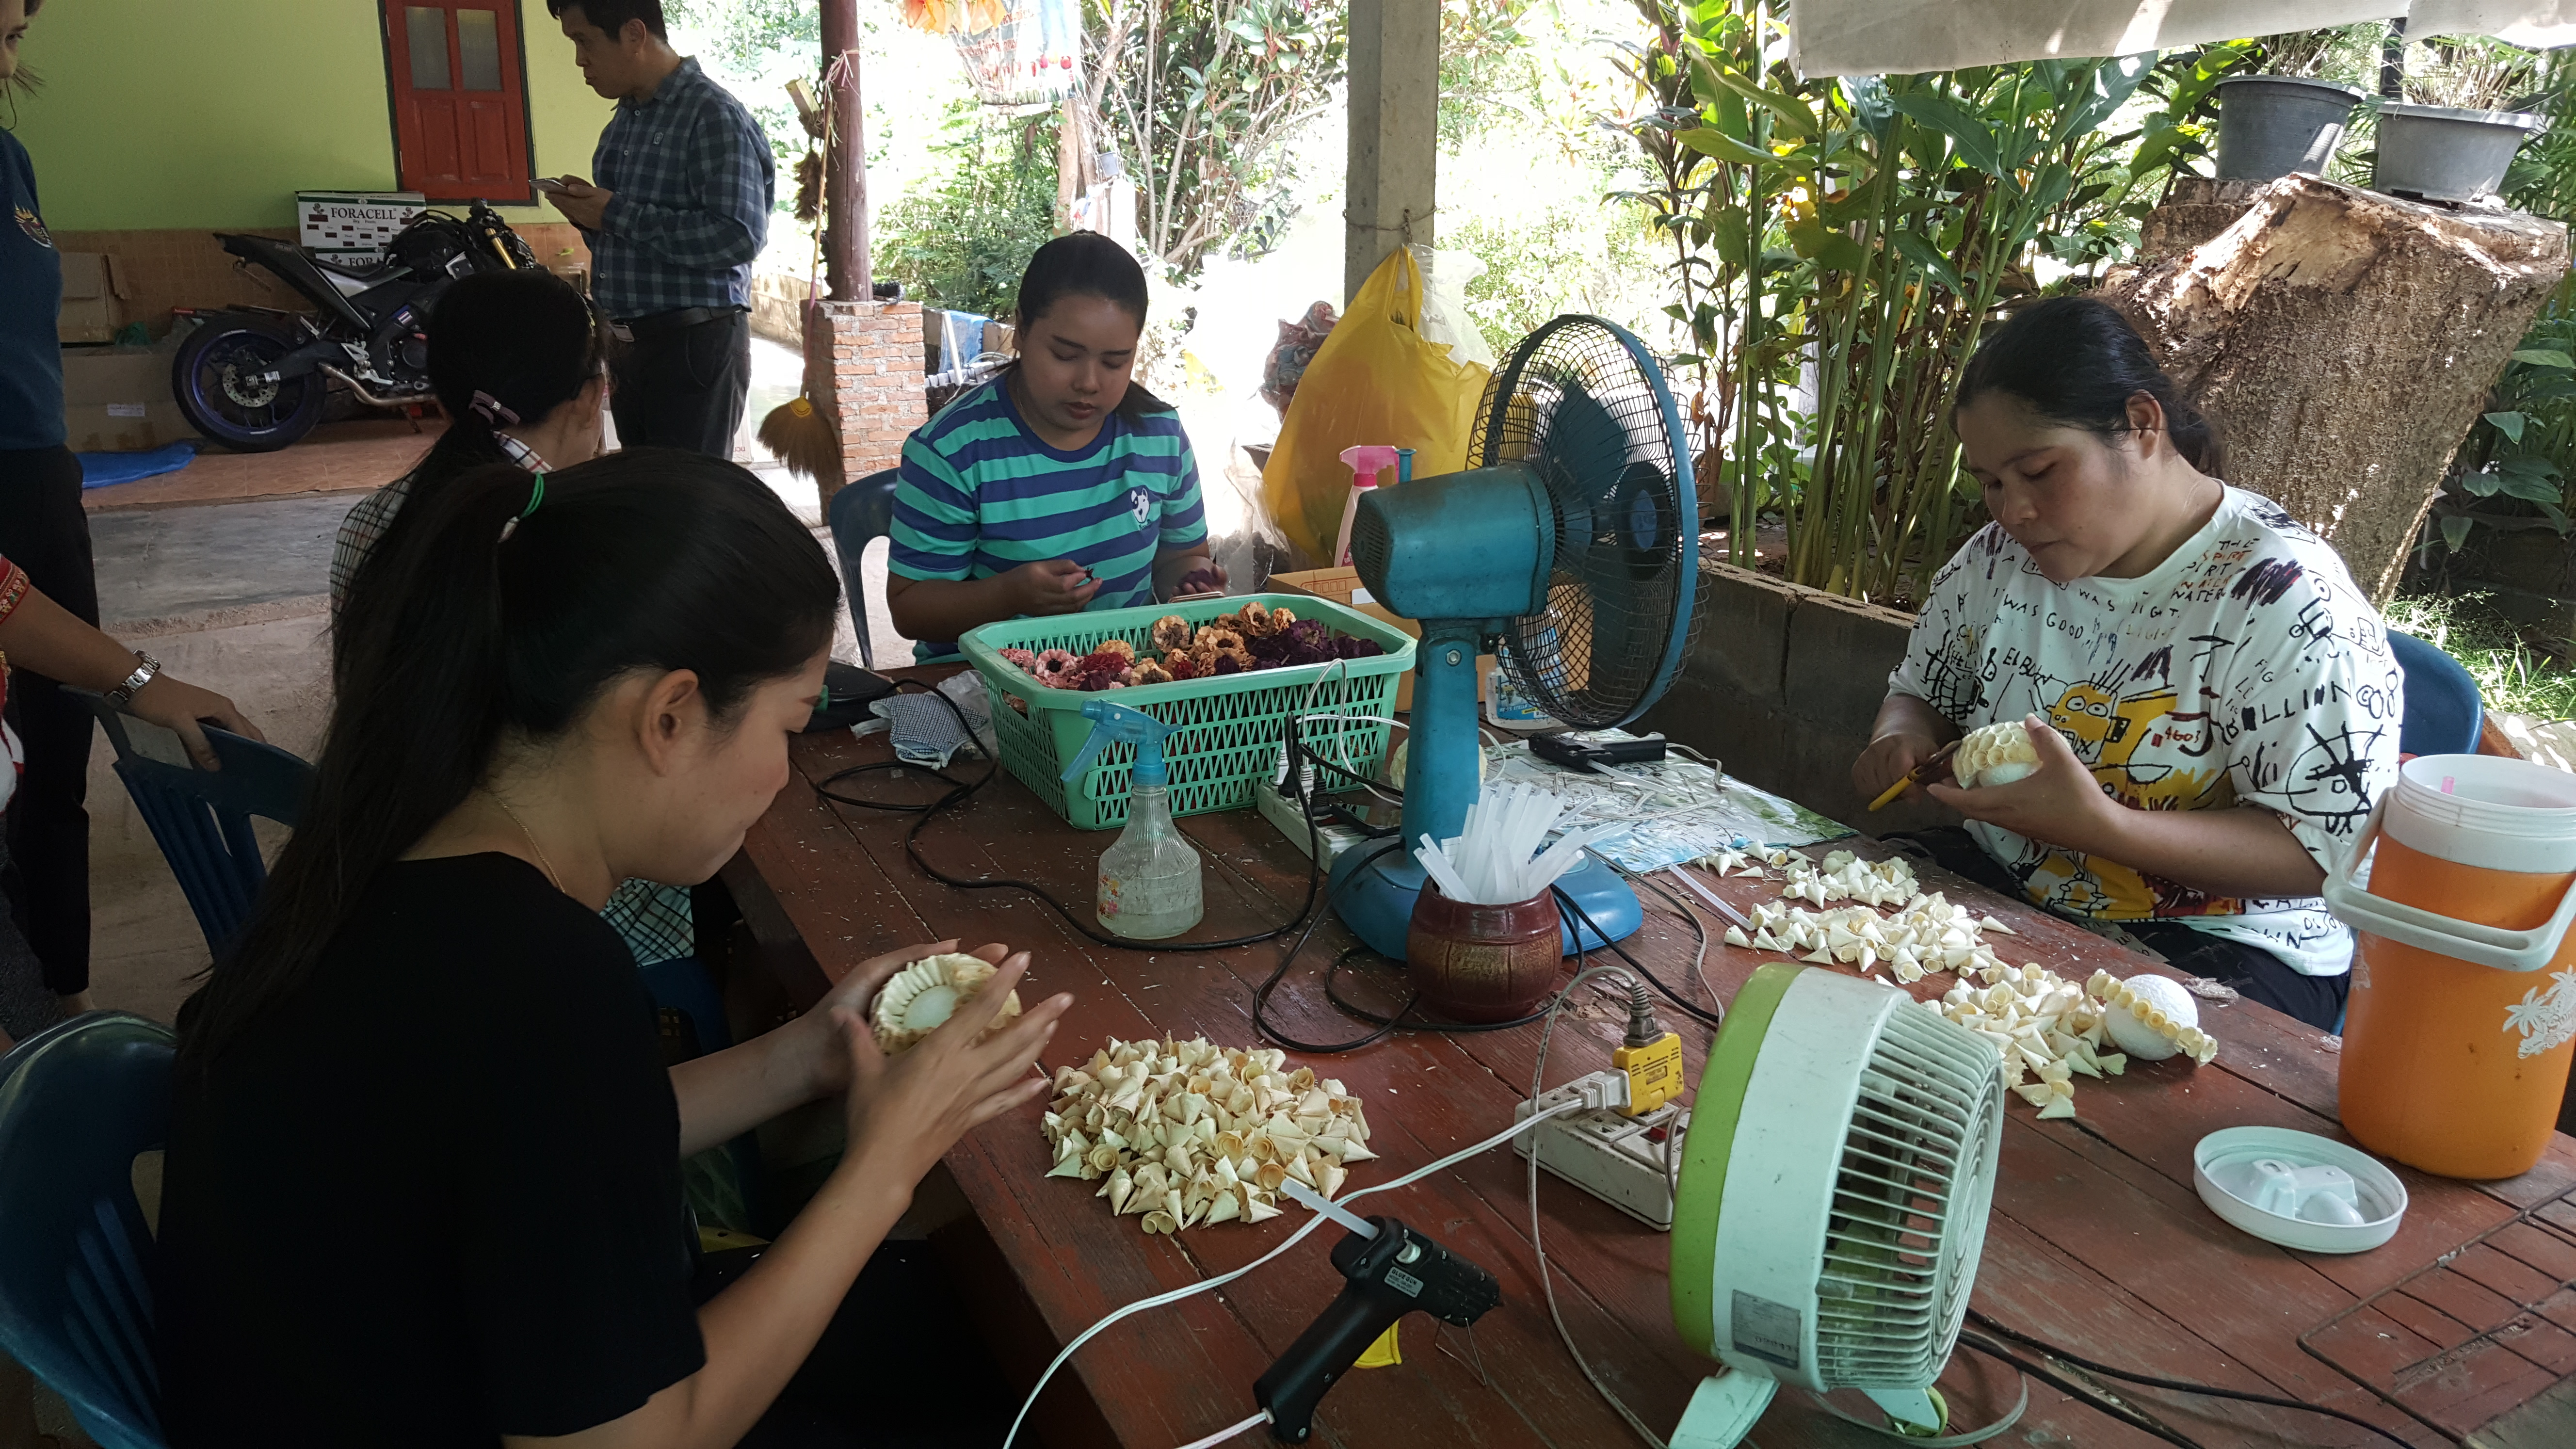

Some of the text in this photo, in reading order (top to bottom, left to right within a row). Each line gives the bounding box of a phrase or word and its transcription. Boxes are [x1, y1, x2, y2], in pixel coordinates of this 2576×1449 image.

[331, 207, 395, 220] FORACELL
[2003, 594, 2038, 616] WAS
[2046, 612, 2083, 639] GOOD
